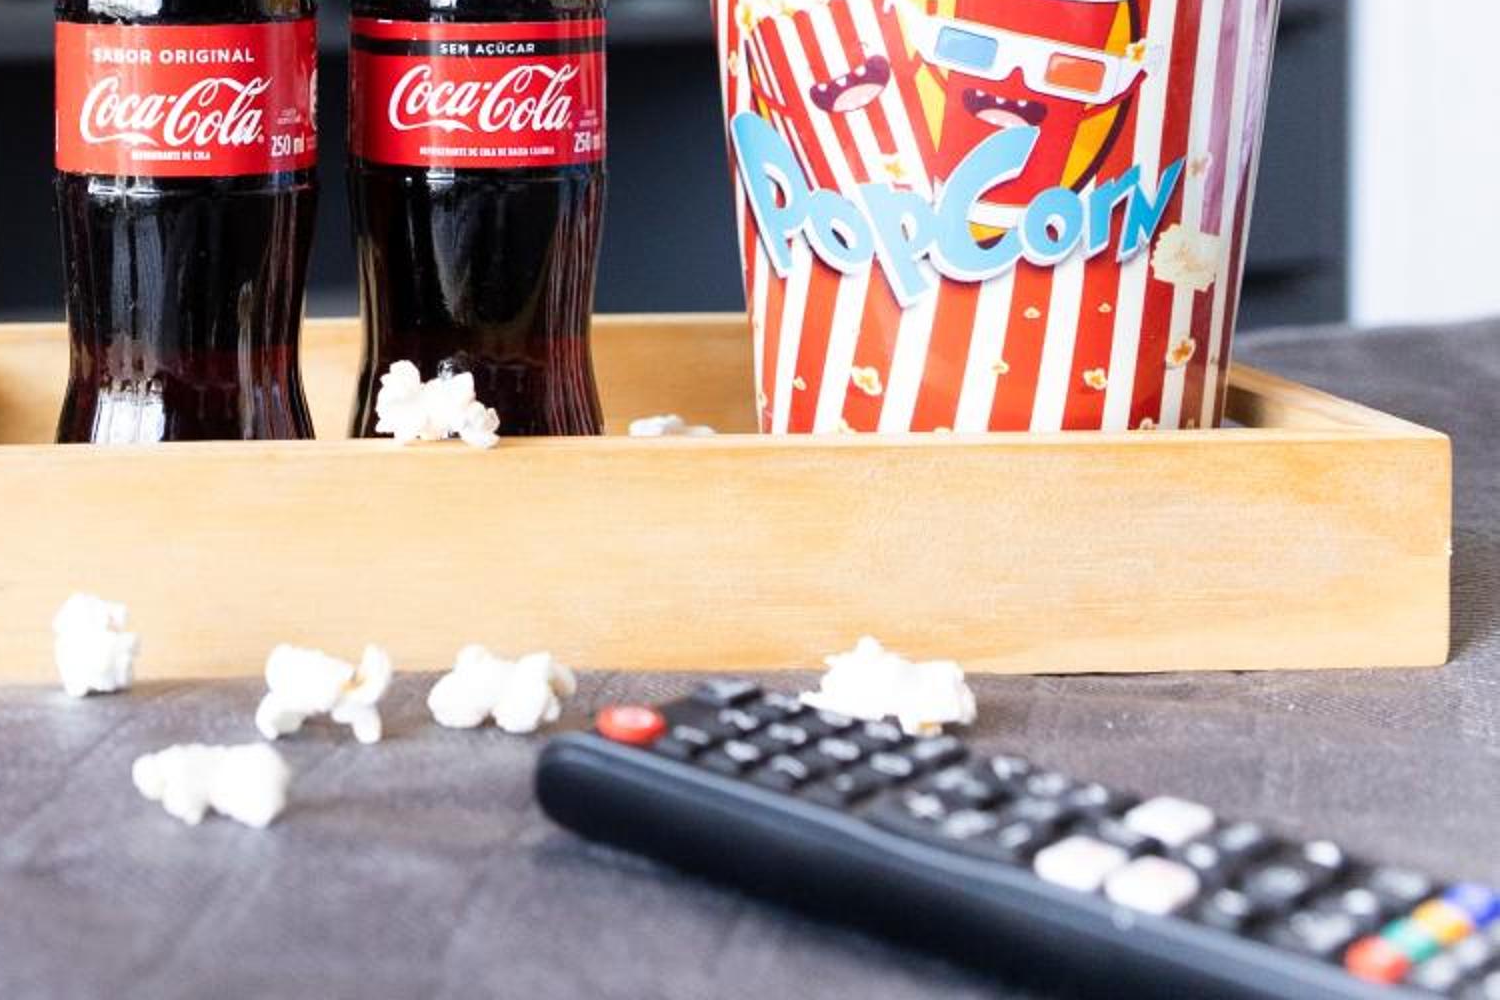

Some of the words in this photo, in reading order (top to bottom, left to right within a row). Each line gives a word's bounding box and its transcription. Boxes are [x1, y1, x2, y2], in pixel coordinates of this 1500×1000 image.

[92, 47, 150, 63] SABOR
[159, 47, 255, 63] ORIGINAL
[439, 43, 469, 55] SEM
[475, 42, 536, 56] AÇÚCAR
[388, 63, 579, 133] Coca-Cola
[79, 75, 273, 147] Coca-Cola
[270, 133, 291, 157] 250
